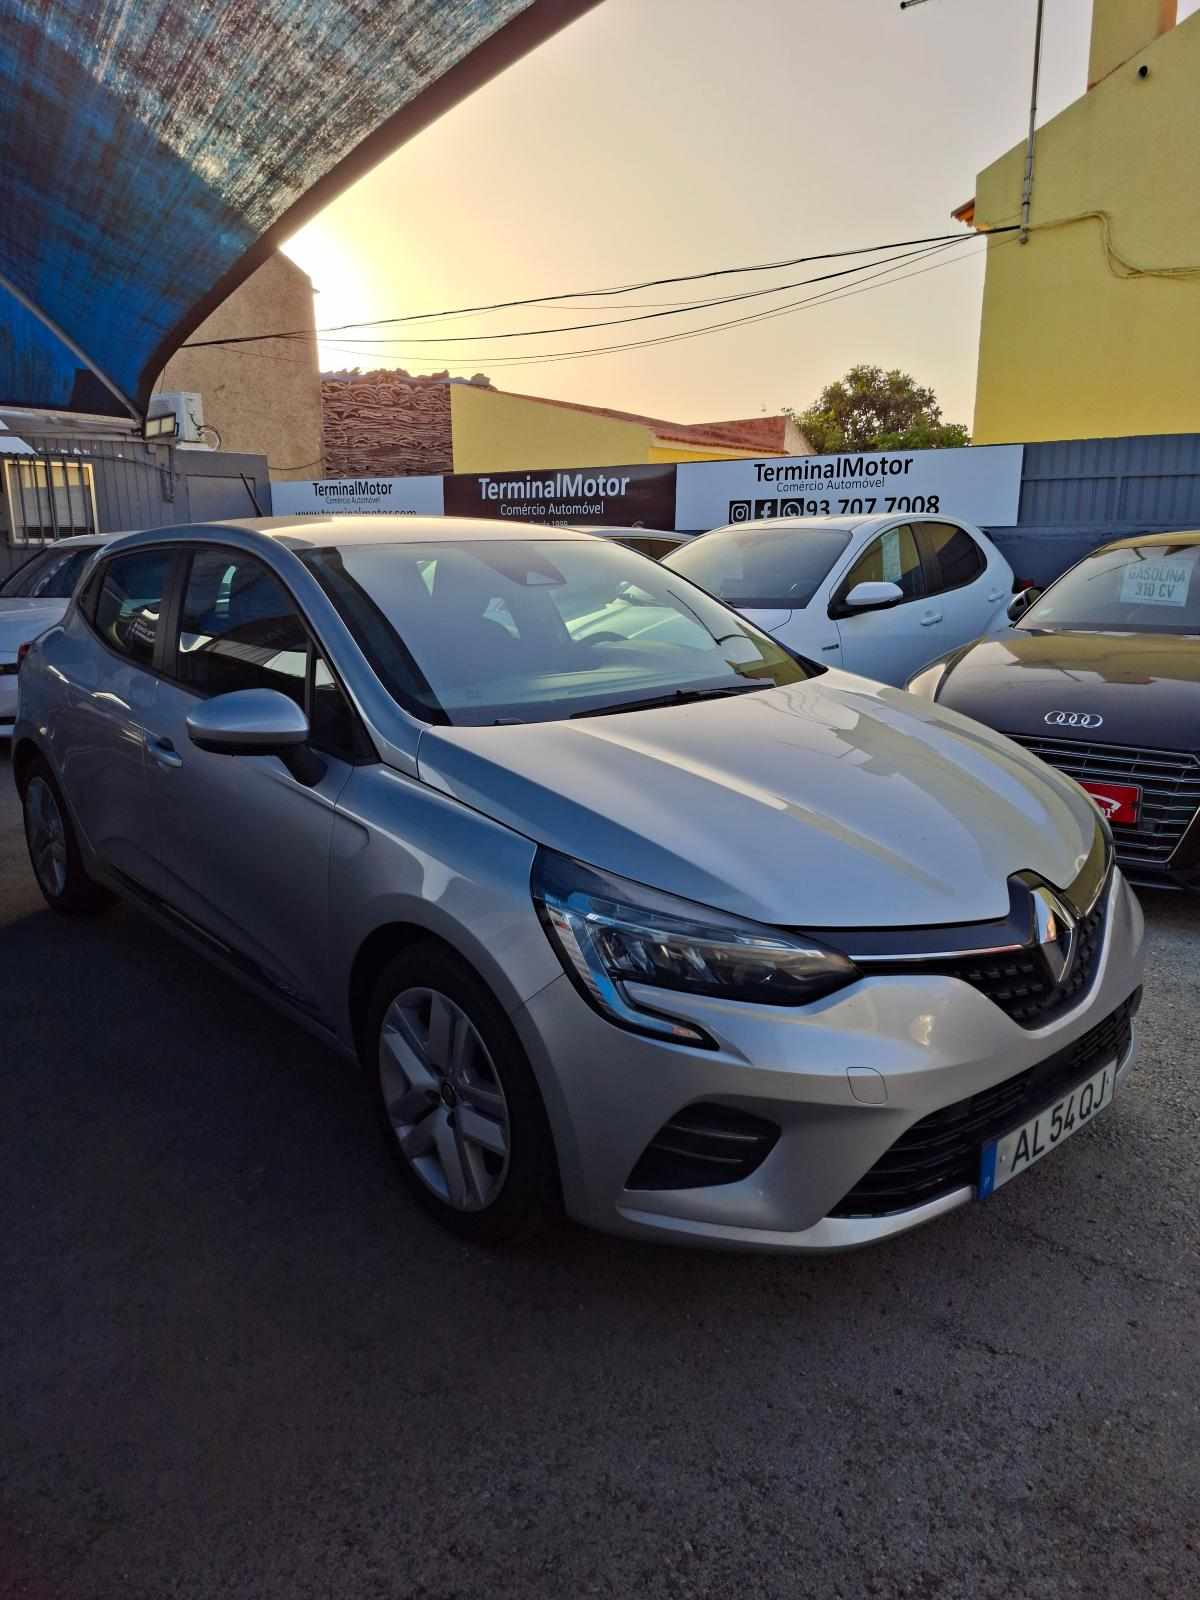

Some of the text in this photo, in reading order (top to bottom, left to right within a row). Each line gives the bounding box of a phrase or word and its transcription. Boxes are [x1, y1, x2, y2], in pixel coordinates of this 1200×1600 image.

[754, 457, 914, 482] TerminalMotor
[312, 481, 393, 496] TerminalMotor
[478, 473, 631, 500] TerminalMotor
[776, 477, 885, 493] Comércio Automóvel
[296, 507, 417, 516] terminalmotorcom
[500, 501, 604, 516] Comércio Automóvel
[806, 500, 830, 516] 93
[838, 498, 877, 514] 707
[884, 495, 940, 514] 7008
[1128, 567, 1186, 582] GASOLINA
[1159, 583, 1175, 598] CV
[1010, 1071, 1106, 1173] AL 54 QJ
